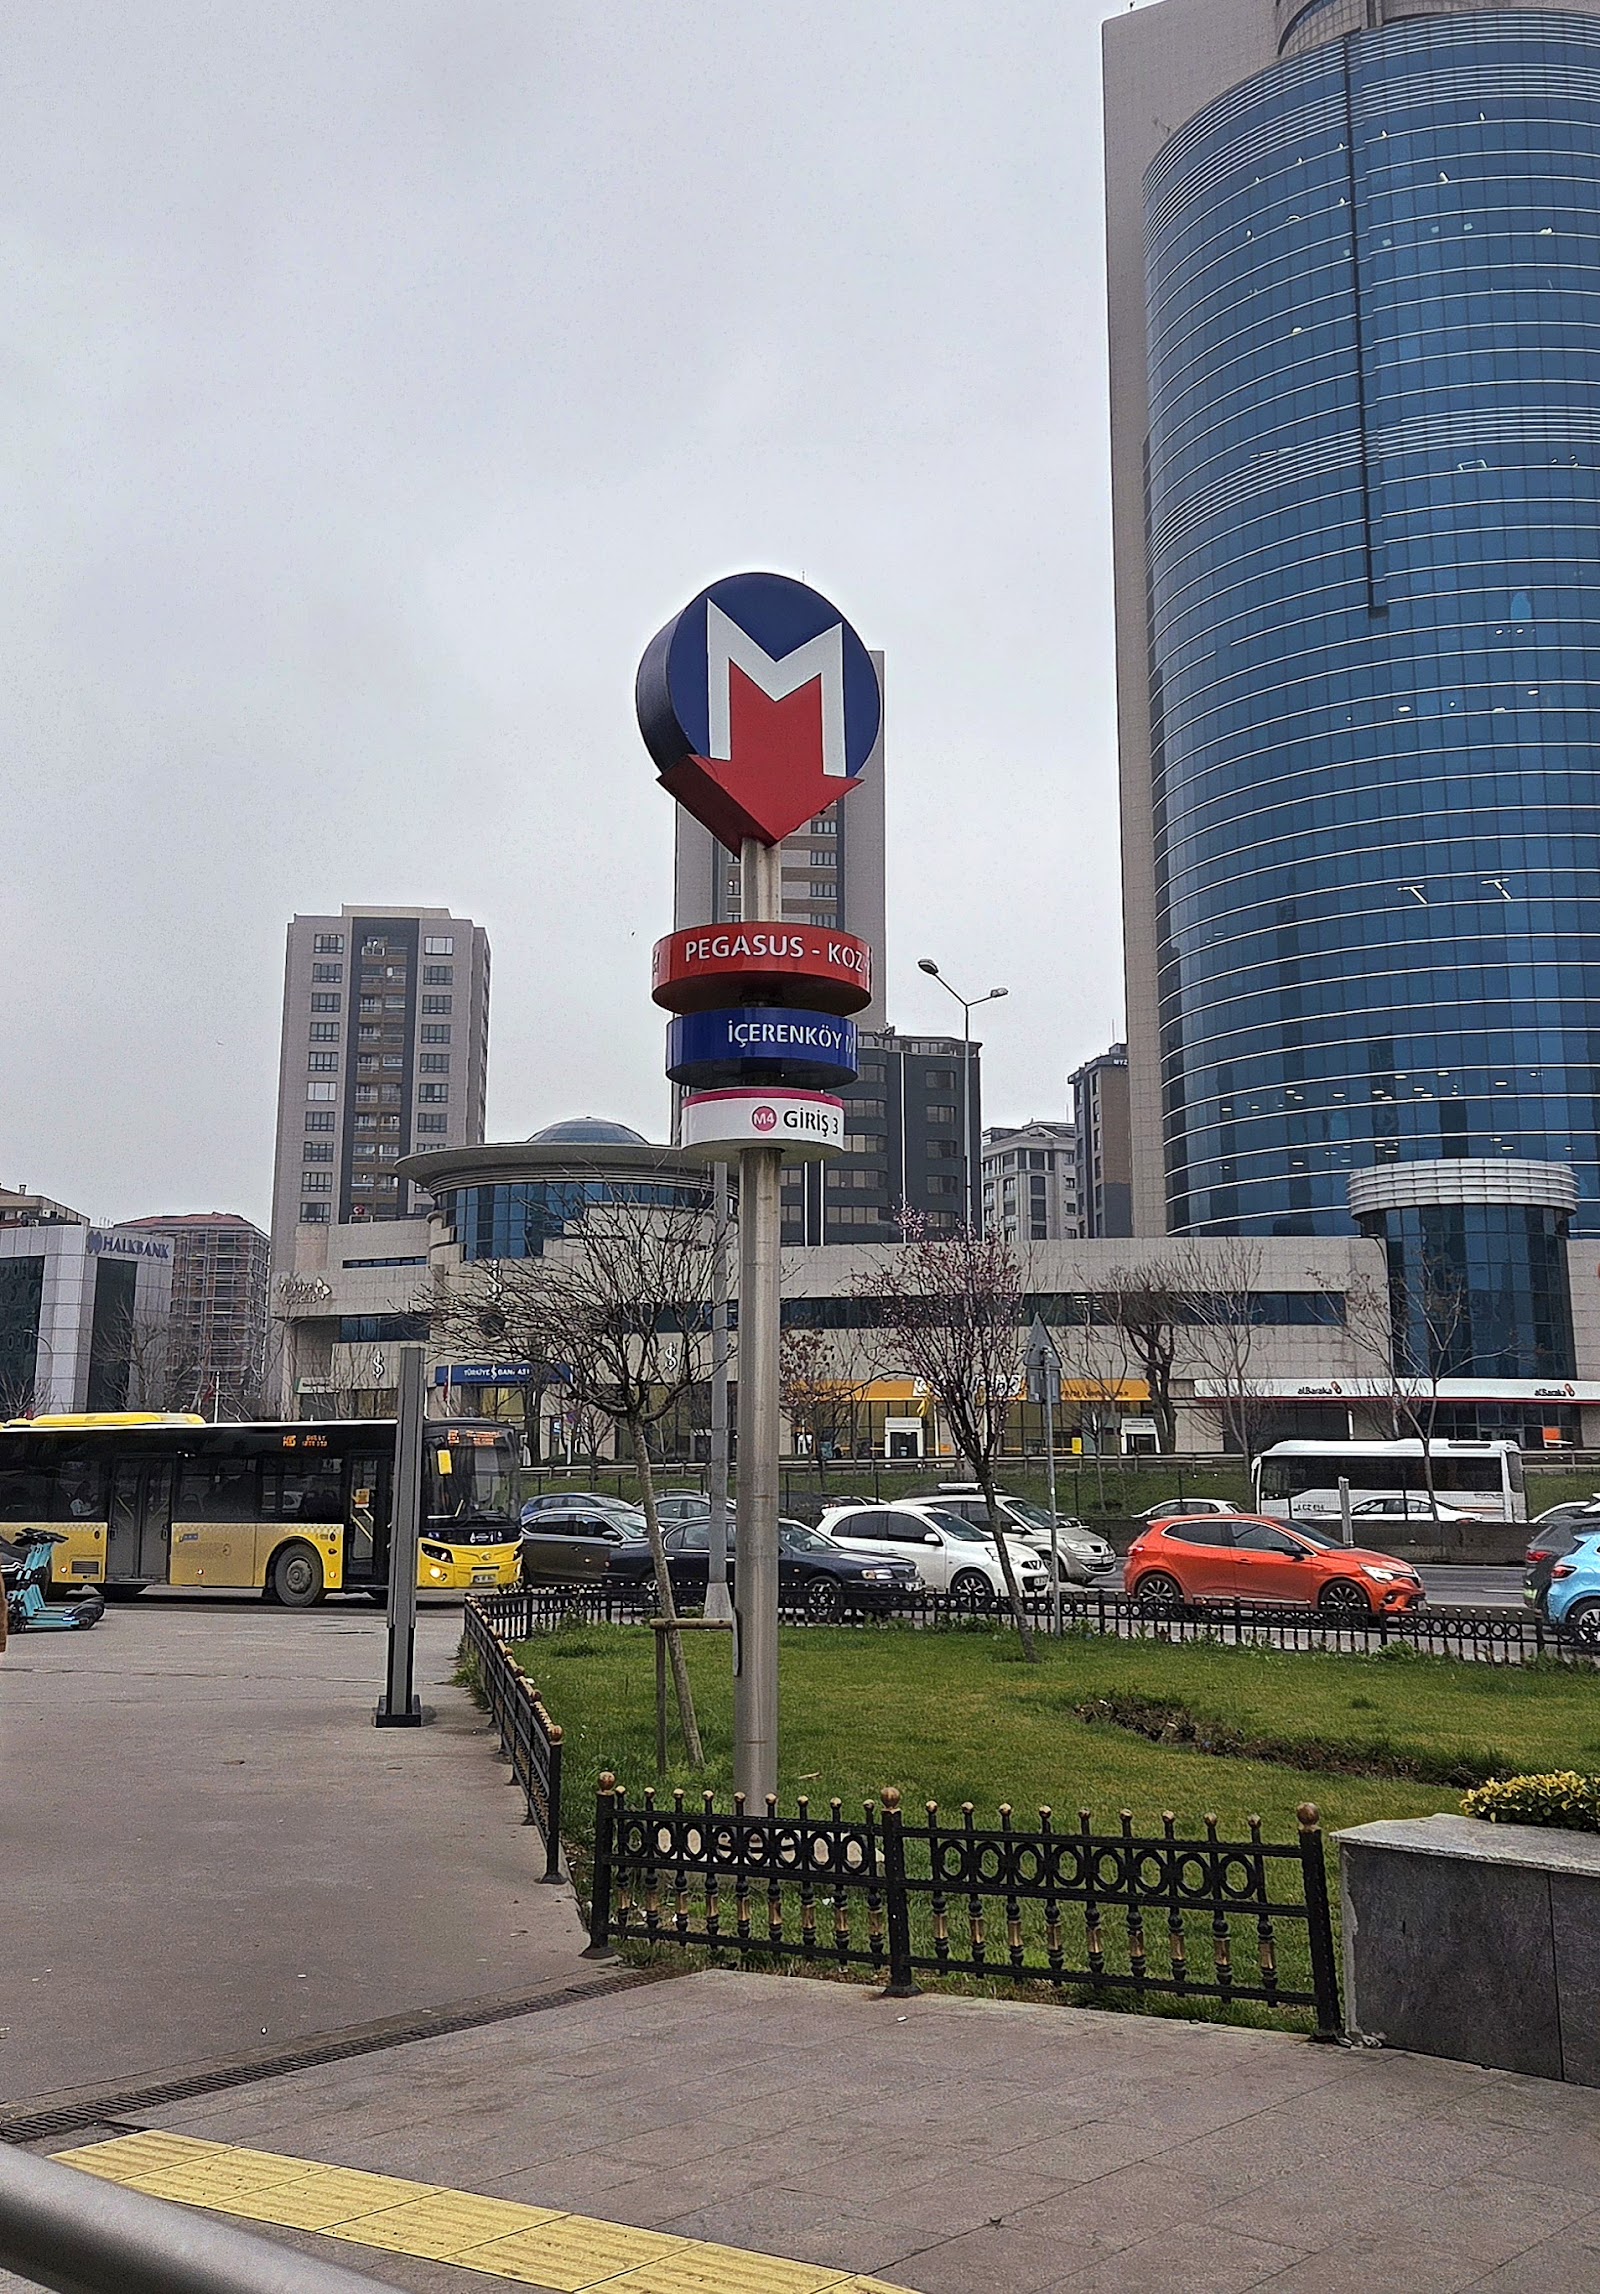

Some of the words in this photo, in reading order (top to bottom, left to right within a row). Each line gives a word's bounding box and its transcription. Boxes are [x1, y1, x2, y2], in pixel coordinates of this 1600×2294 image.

[707, 597, 847, 778] M
[685, 934, 804, 962] PEGASUS
[828, 941, 868, 973] KOZ
[728, 1020, 842, 1050] İÇERENKÖY
[753, 1113, 775, 1125] M4
[783, 1107, 829, 1137] GİRİŞ
[832, 1117, 839, 1135] 3
[103, 1236, 169, 1259] HALKBANK
[498, 1367, 530, 1376] BANASI
